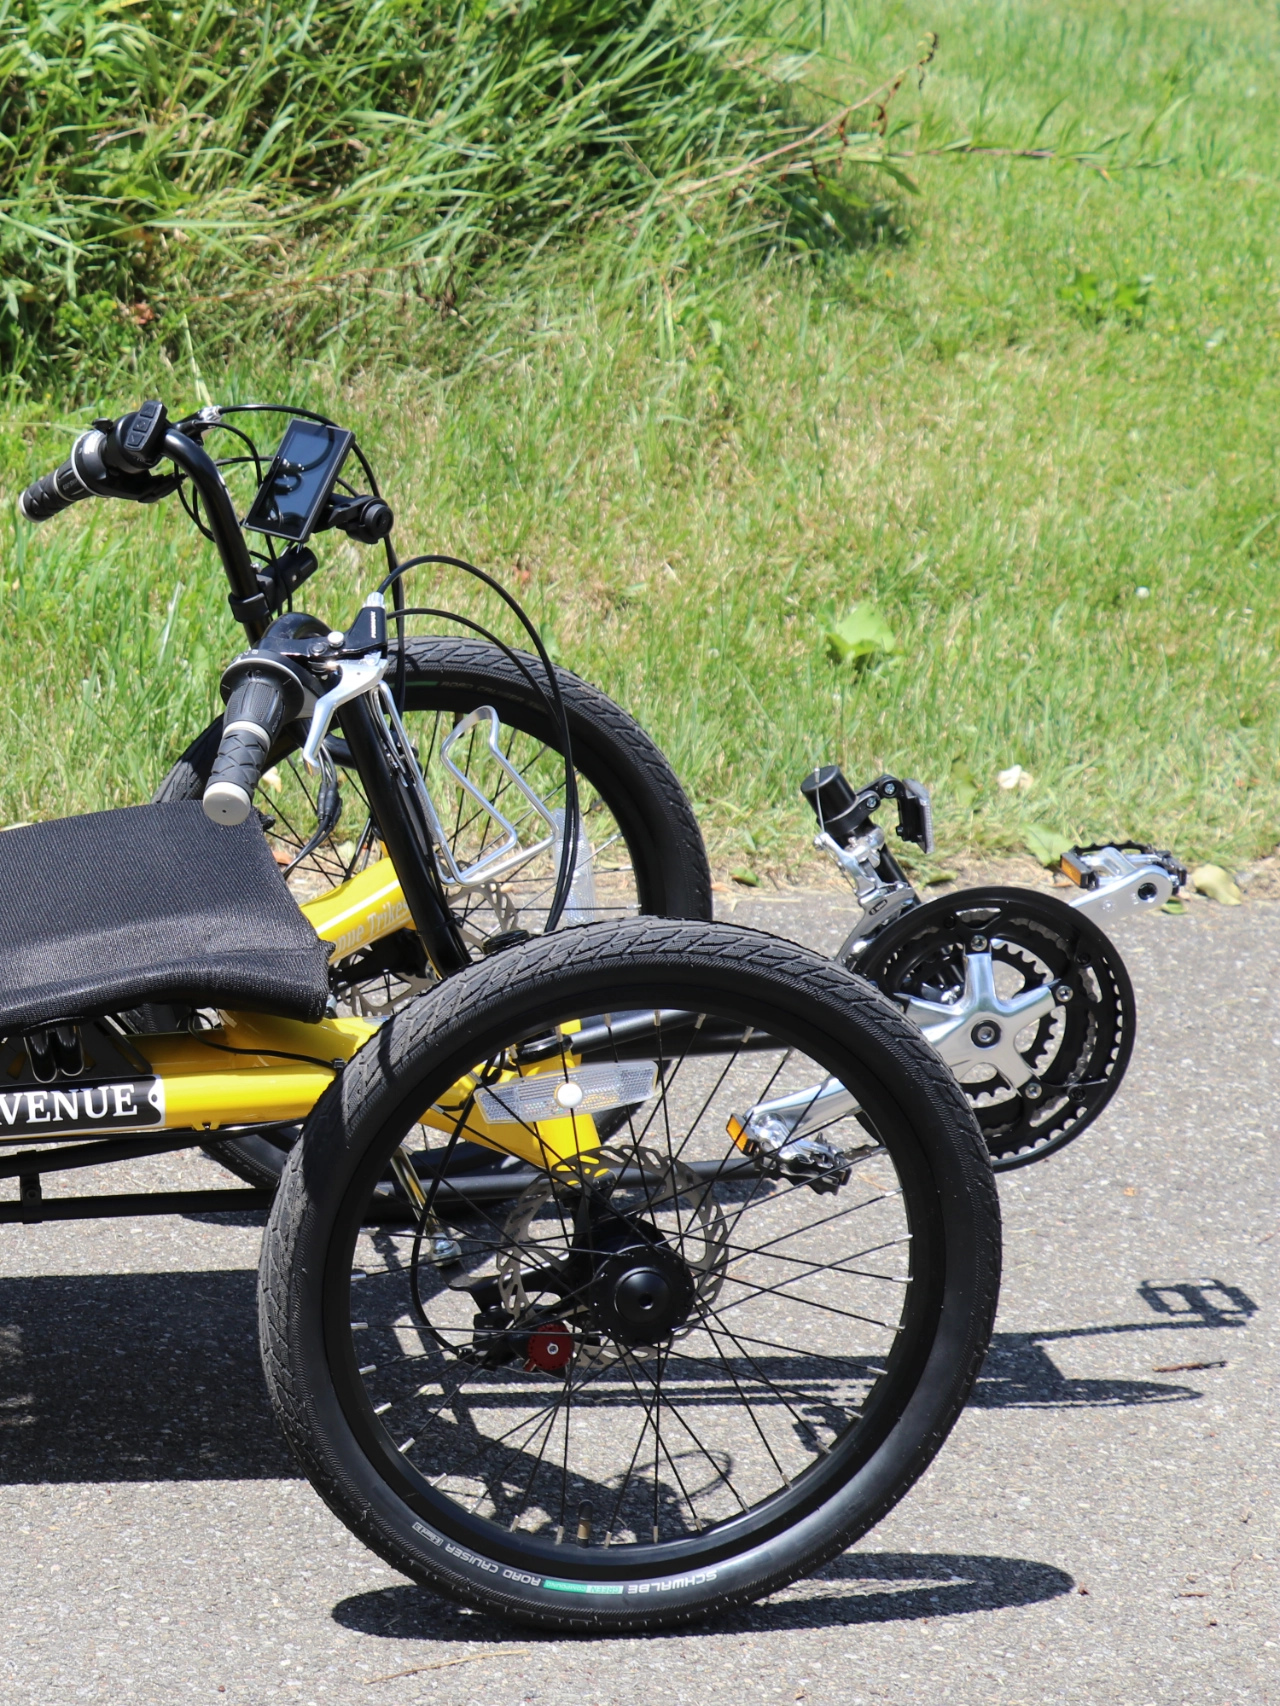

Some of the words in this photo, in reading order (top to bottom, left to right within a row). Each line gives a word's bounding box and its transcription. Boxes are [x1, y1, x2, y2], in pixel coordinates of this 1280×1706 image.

[445, 1543, 499, 1574] CRUISER
[503, 1569, 541, 1587] ROAD
[546, 1581, 586, 1592] COMPOUND
[628, 1570, 718, 1594] SCHWALBE
[590, 1585, 621, 1594] GREEN
